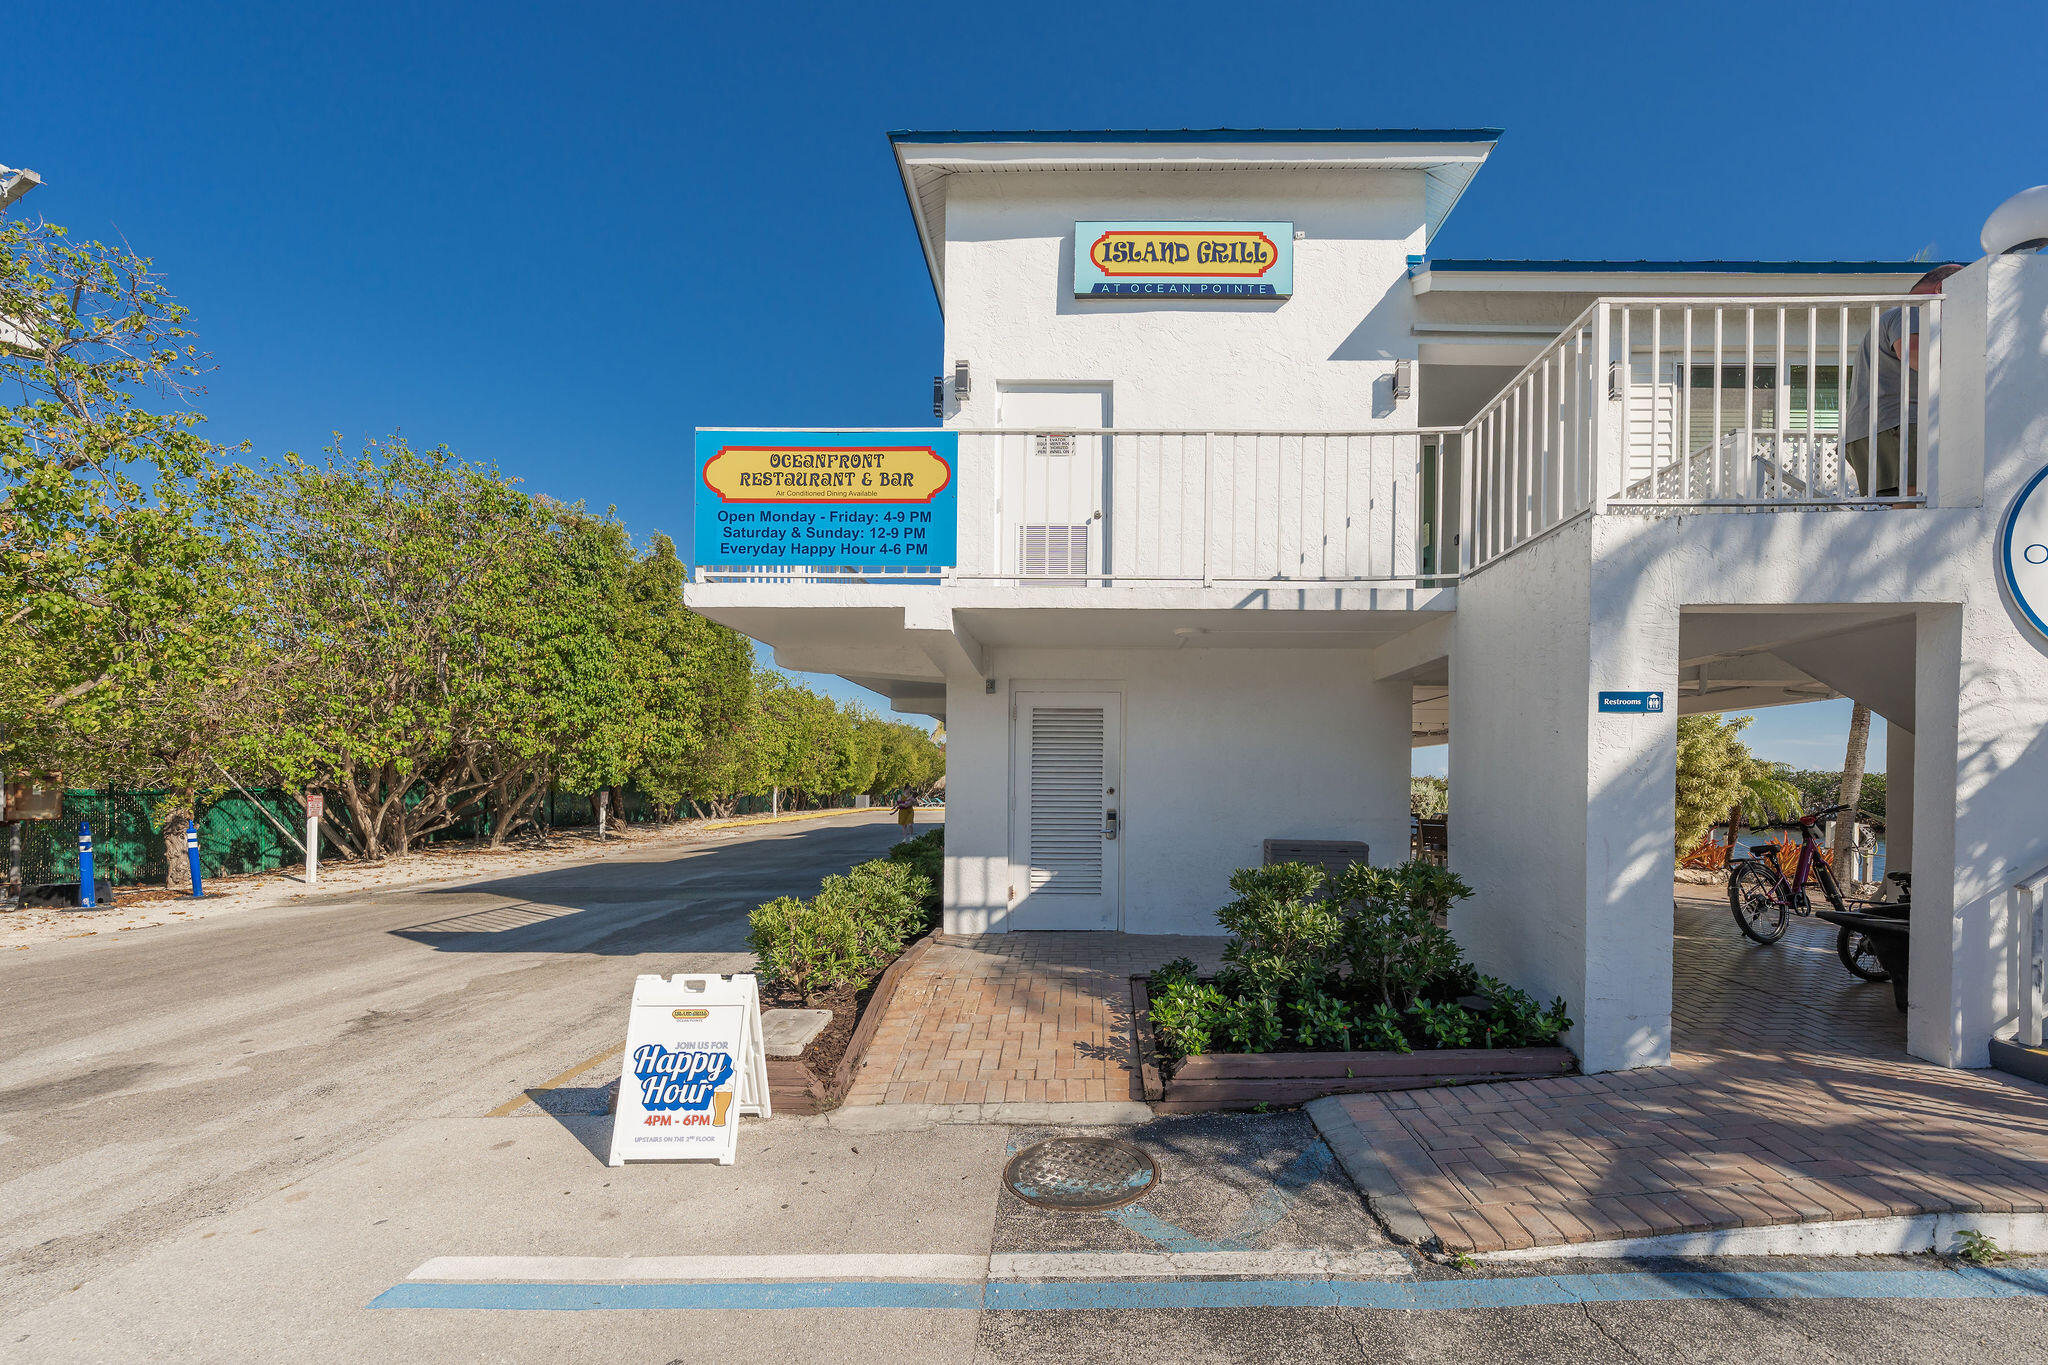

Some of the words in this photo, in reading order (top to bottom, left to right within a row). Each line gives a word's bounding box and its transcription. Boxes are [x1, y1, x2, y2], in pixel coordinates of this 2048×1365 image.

[1102, 241, 1189, 264] ISLAND
[1196, 241, 1267, 264] GRILL
[1101, 283, 1121, 293] AT
[1131, 283, 1191, 293] OCEAN
[1201, 284, 1267, 293] POINTE
[770, 454, 884, 468] OCEANFRONT
[740, 472, 855, 487] RESTAURANT
[862, 472, 872, 486] &
[880, 472, 914, 487] BAR
[827, 490, 847, 498] Dining
[717, 510, 755, 524] Open
[760, 510, 816, 525] Monday
[830, 511, 879, 525] Friday:
[883, 511, 905, 522] 4-9
[910, 511, 931, 522] PM
[723, 526, 786, 541] Saturday
[791, 527, 801, 538] &
[806, 527, 864, 541] Sunday:
[870, 527, 899, 539] 12-9
[904, 527, 926, 539] PM
[720, 542, 786, 557] Everyday
[791, 543, 836, 557] Happy
[841, 543, 875, 555] Hour
[880, 543, 901, 555] 4-6
[906, 543, 928, 555] PM
[675, 1042, 696, 1050] JOIN
[697, 1042, 709, 1050] US
[710, 1042, 728, 1050] FOR
[634, 1044, 729, 1082] Happy
[641, 1075, 714, 1106] Hour
[644, 1115, 671, 1126] 4PM
[682, 1115, 710, 1126] 6PM
